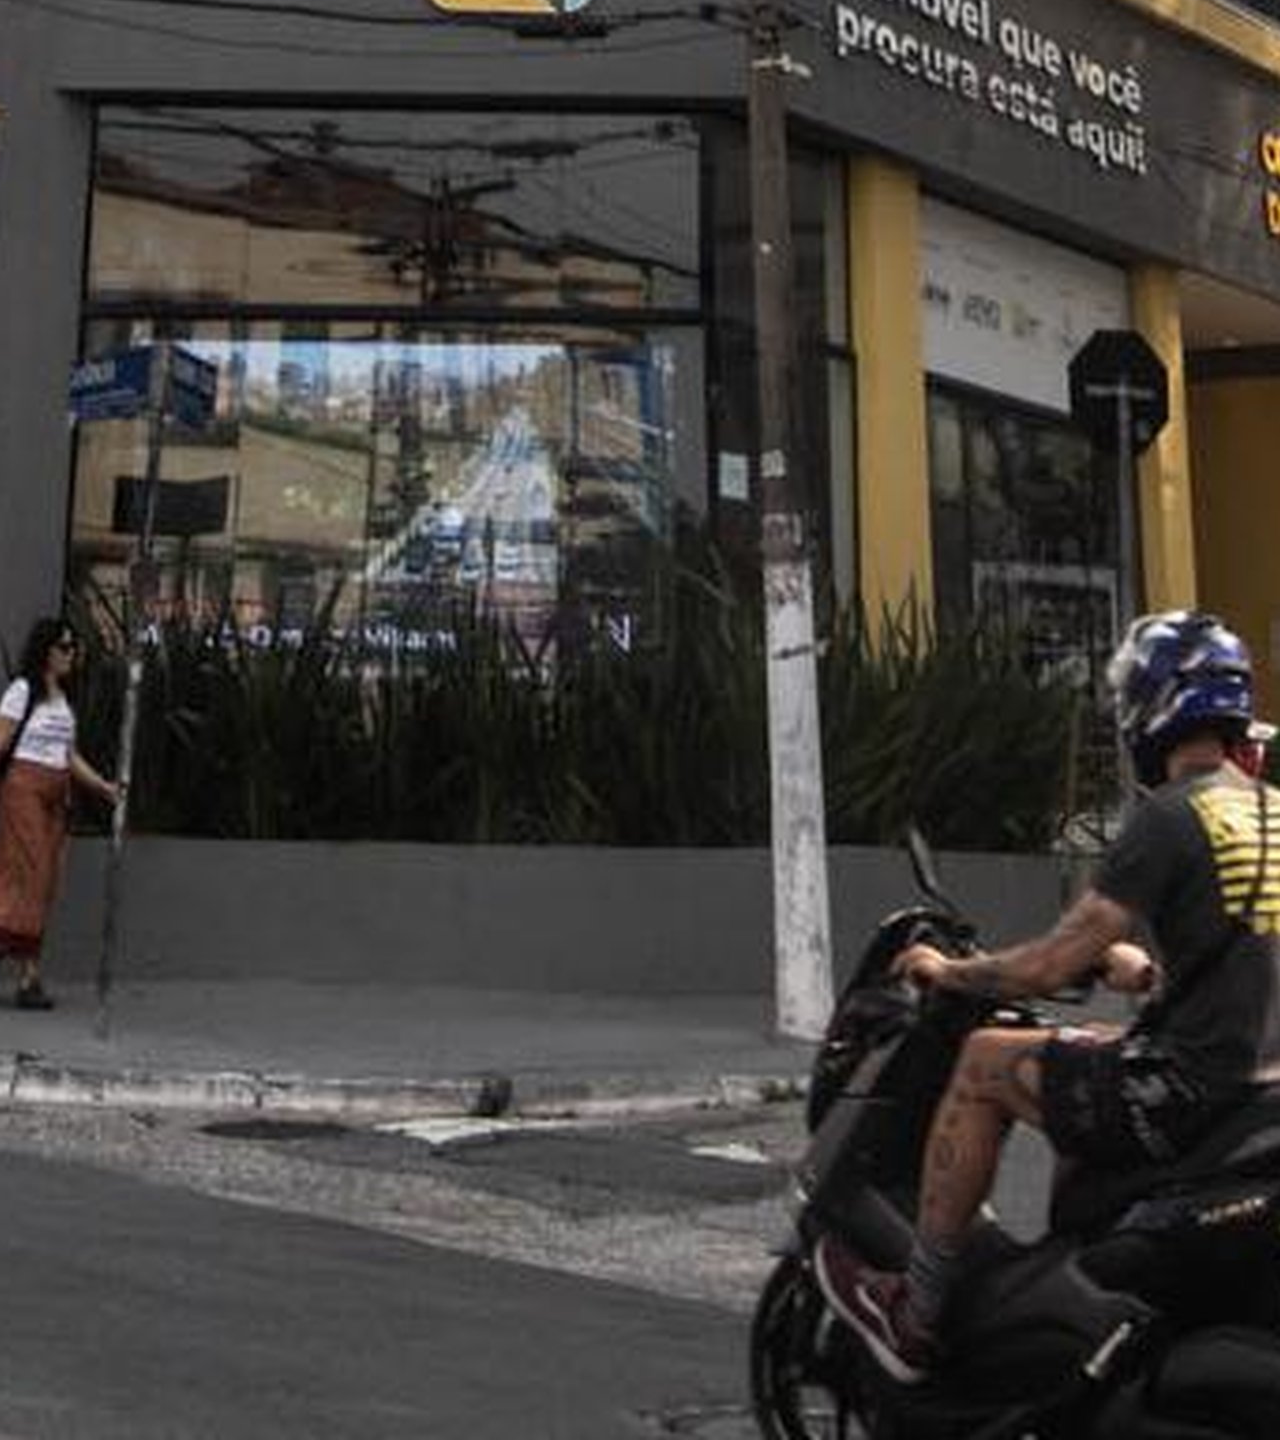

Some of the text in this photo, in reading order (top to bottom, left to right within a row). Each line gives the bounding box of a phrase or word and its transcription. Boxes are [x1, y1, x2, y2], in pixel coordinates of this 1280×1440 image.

[836, 4, 979, 99] procura
[987, 74, 1059, 136] está
[999, 18, 1061, 76] que
[1069, 48, 1144, 113] você
